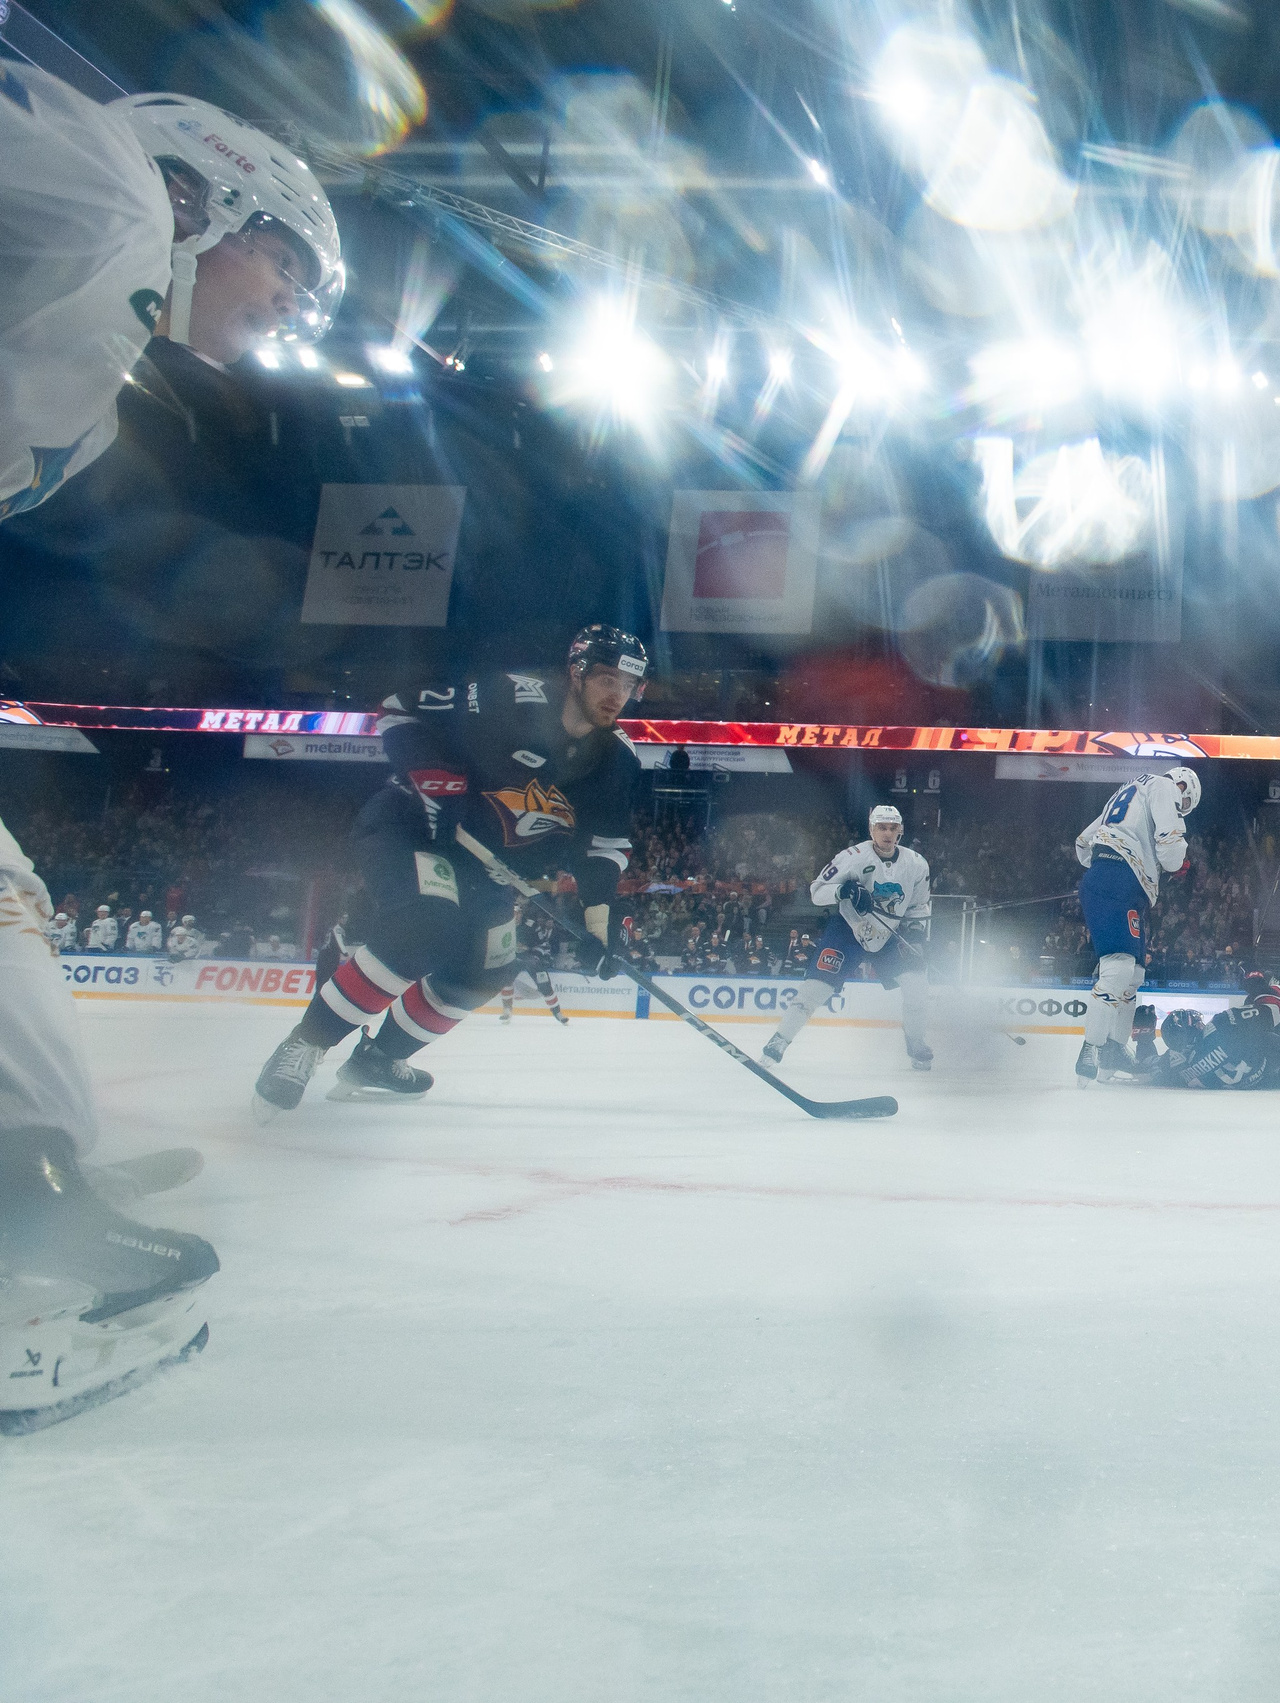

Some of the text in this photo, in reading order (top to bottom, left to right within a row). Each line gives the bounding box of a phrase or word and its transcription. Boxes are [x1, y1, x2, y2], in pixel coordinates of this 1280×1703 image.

[203, 133, 256, 173] Forte
[319, 551, 449, 571] ТАЛТЭК
[620, 659, 644, 672] согаз
[417, 687, 456, 710] 21
[467, 682, 480, 714] ONBET
[199, 711, 304, 731] МЕТАЛ
[776, 725, 883, 747] МЕТАЛ
[420, 780, 466, 791] CC
[928, 769, 941, 789] 6
[195, 966, 317, 994] FONBET
[554, 983, 632, 996] Металлоинвест
